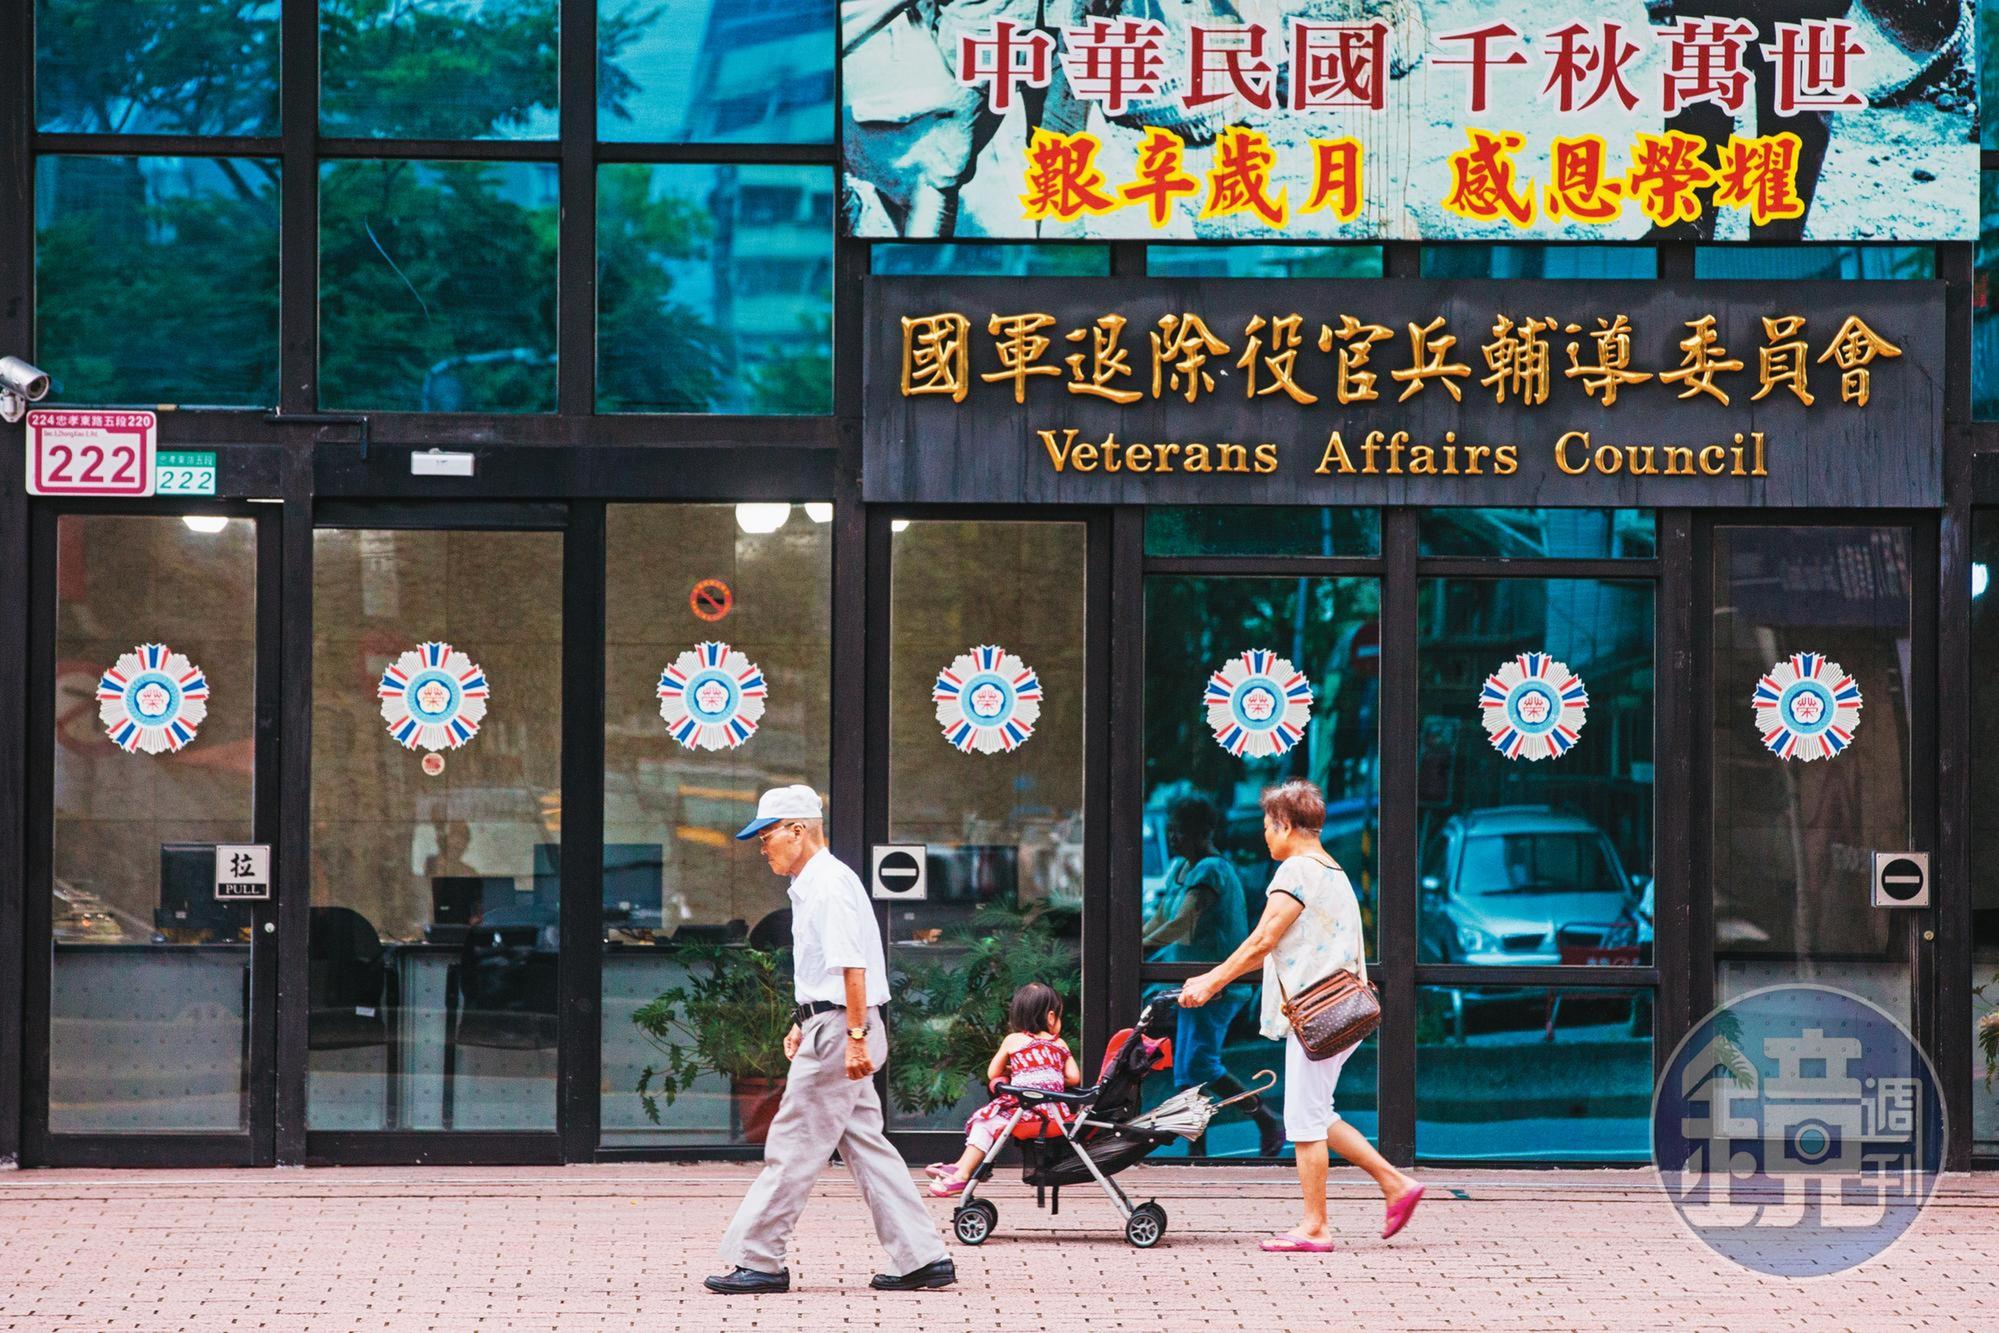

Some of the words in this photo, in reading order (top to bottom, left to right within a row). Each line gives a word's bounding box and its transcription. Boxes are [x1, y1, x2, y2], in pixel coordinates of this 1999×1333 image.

[960, 18, 1390, 112] 中華民國
[1431, 20, 1866, 113] 千秋萬世
[1024, 128, 1364, 226] 艱辛歲月
[1446, 130, 1804, 226] 感恩榮耀
[901, 312, 1902, 407] 國軍退除役官兵輔導委員會
[48, 445, 136, 483] 222
[1037, 428, 1279, 473] Veterans
[1315, 430, 1518, 475] Affairs
[1555, 431, 1768, 476] Council
[160, 471, 212, 489] 222
[230, 852, 255, 878] 拉
[225, 884, 260, 895] PULL
